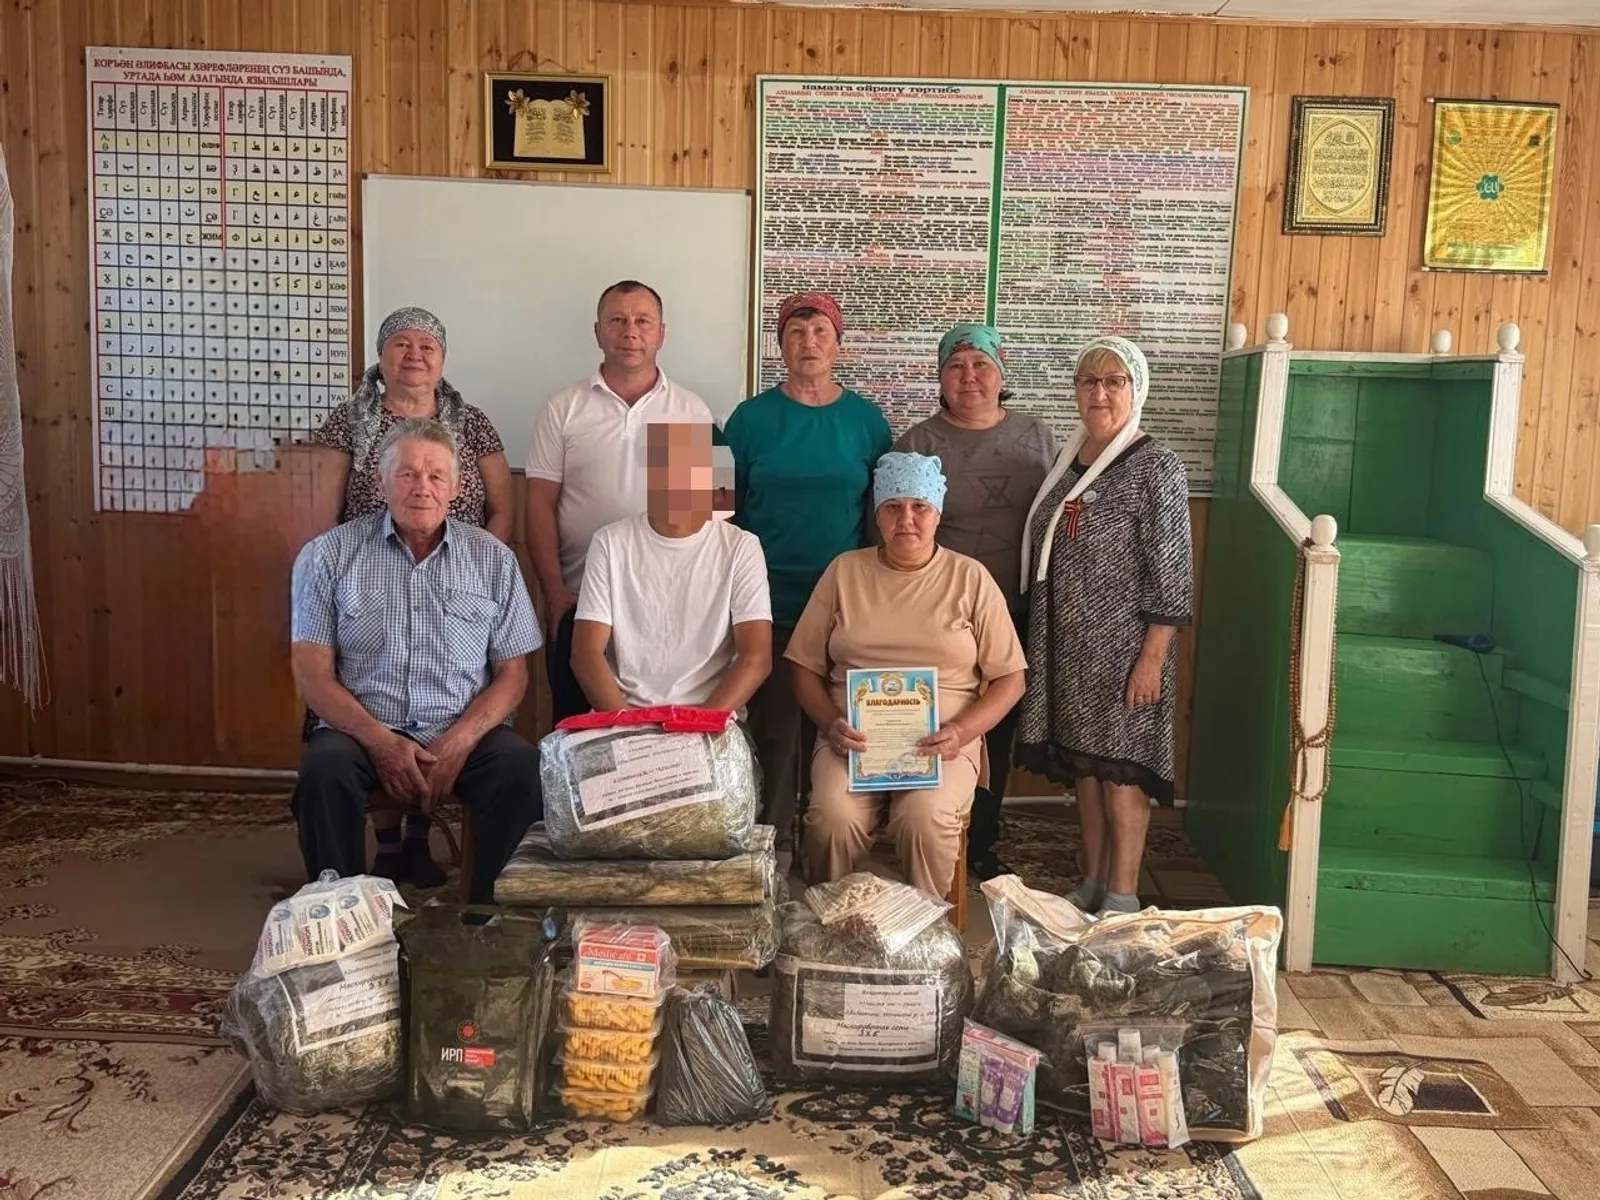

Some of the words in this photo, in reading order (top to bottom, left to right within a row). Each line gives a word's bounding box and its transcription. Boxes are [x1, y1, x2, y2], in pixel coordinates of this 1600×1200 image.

[136, 60, 190, 70] ӘЛИФБАСЫ
[123, 72, 160, 81] УРТАДА
[189, 74, 244, 84] АЗАГЫНДА
[246, 76, 318, 86] ЯЗЫЛЫШЛАРЫ
[866, 698, 920, 706] БЛАГОДАРНОСТЬ
[441, 1047, 463, 1062] ИРП
